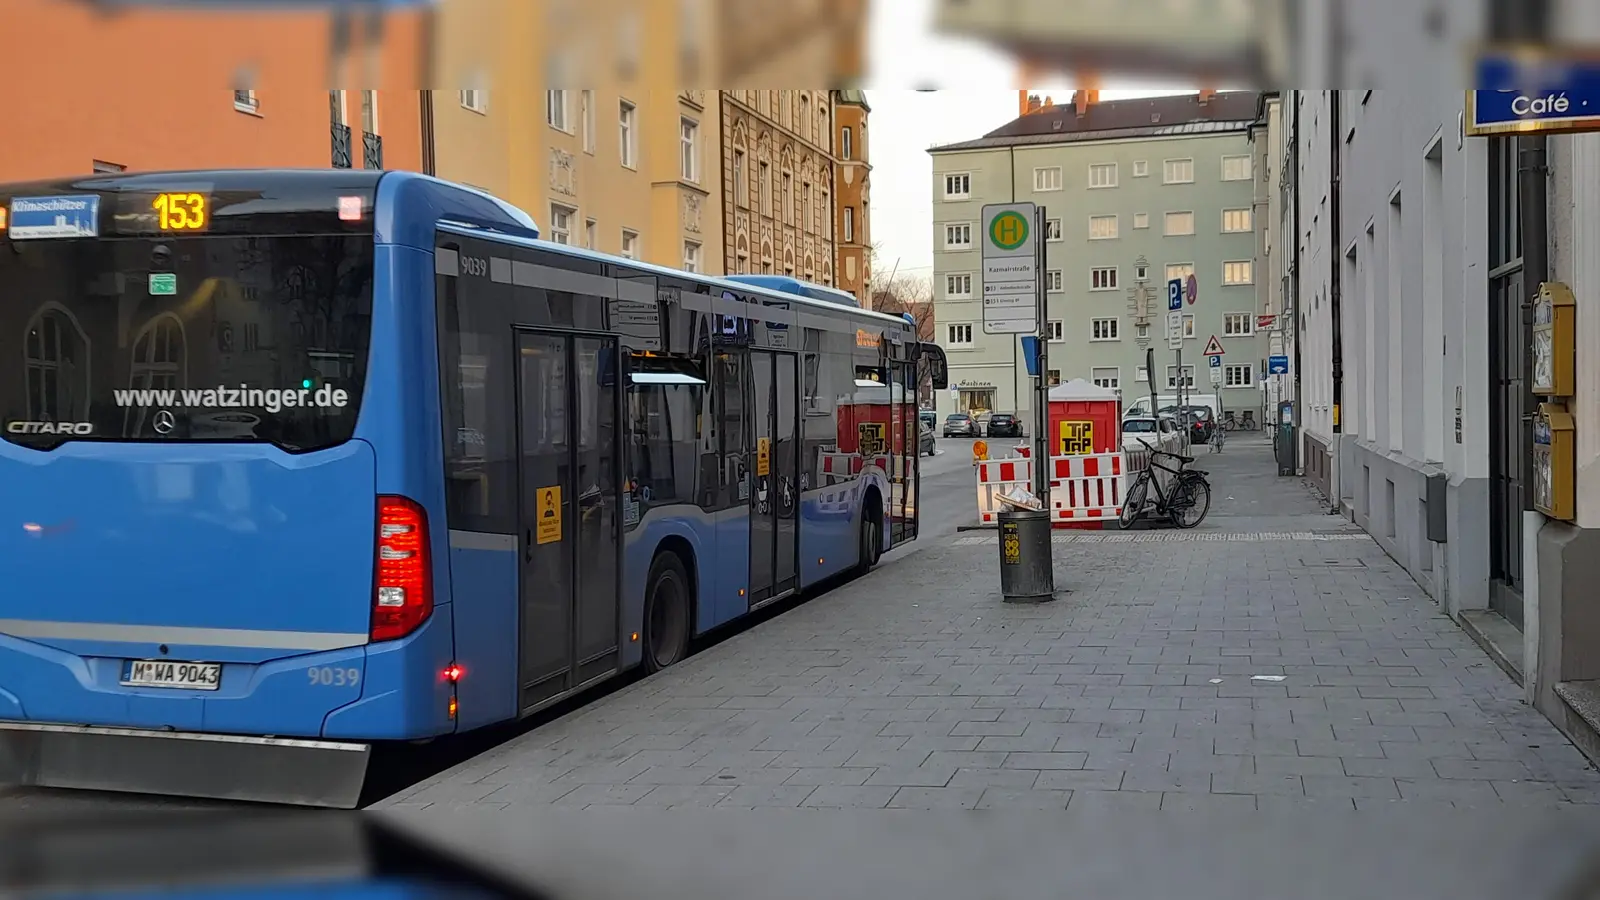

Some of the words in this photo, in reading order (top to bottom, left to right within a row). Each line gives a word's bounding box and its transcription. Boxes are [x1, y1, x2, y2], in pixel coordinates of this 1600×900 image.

[1511, 92, 1570, 115] Café
[152, 193, 205, 230] 153
[1000, 219, 1018, 242] H
[461, 256, 487, 277] 9039
[988, 265, 1031, 273] Kazmairstraße
[1169, 283, 1178, 307] P
[114, 383, 348, 413] www.watzinger.de
[7, 421, 94, 435] CITARO
[133, 663, 145, 681] M
[154, 664, 175, 682] WA
[178, 665, 219, 684] 9043
[308, 666, 360, 688] 9039
